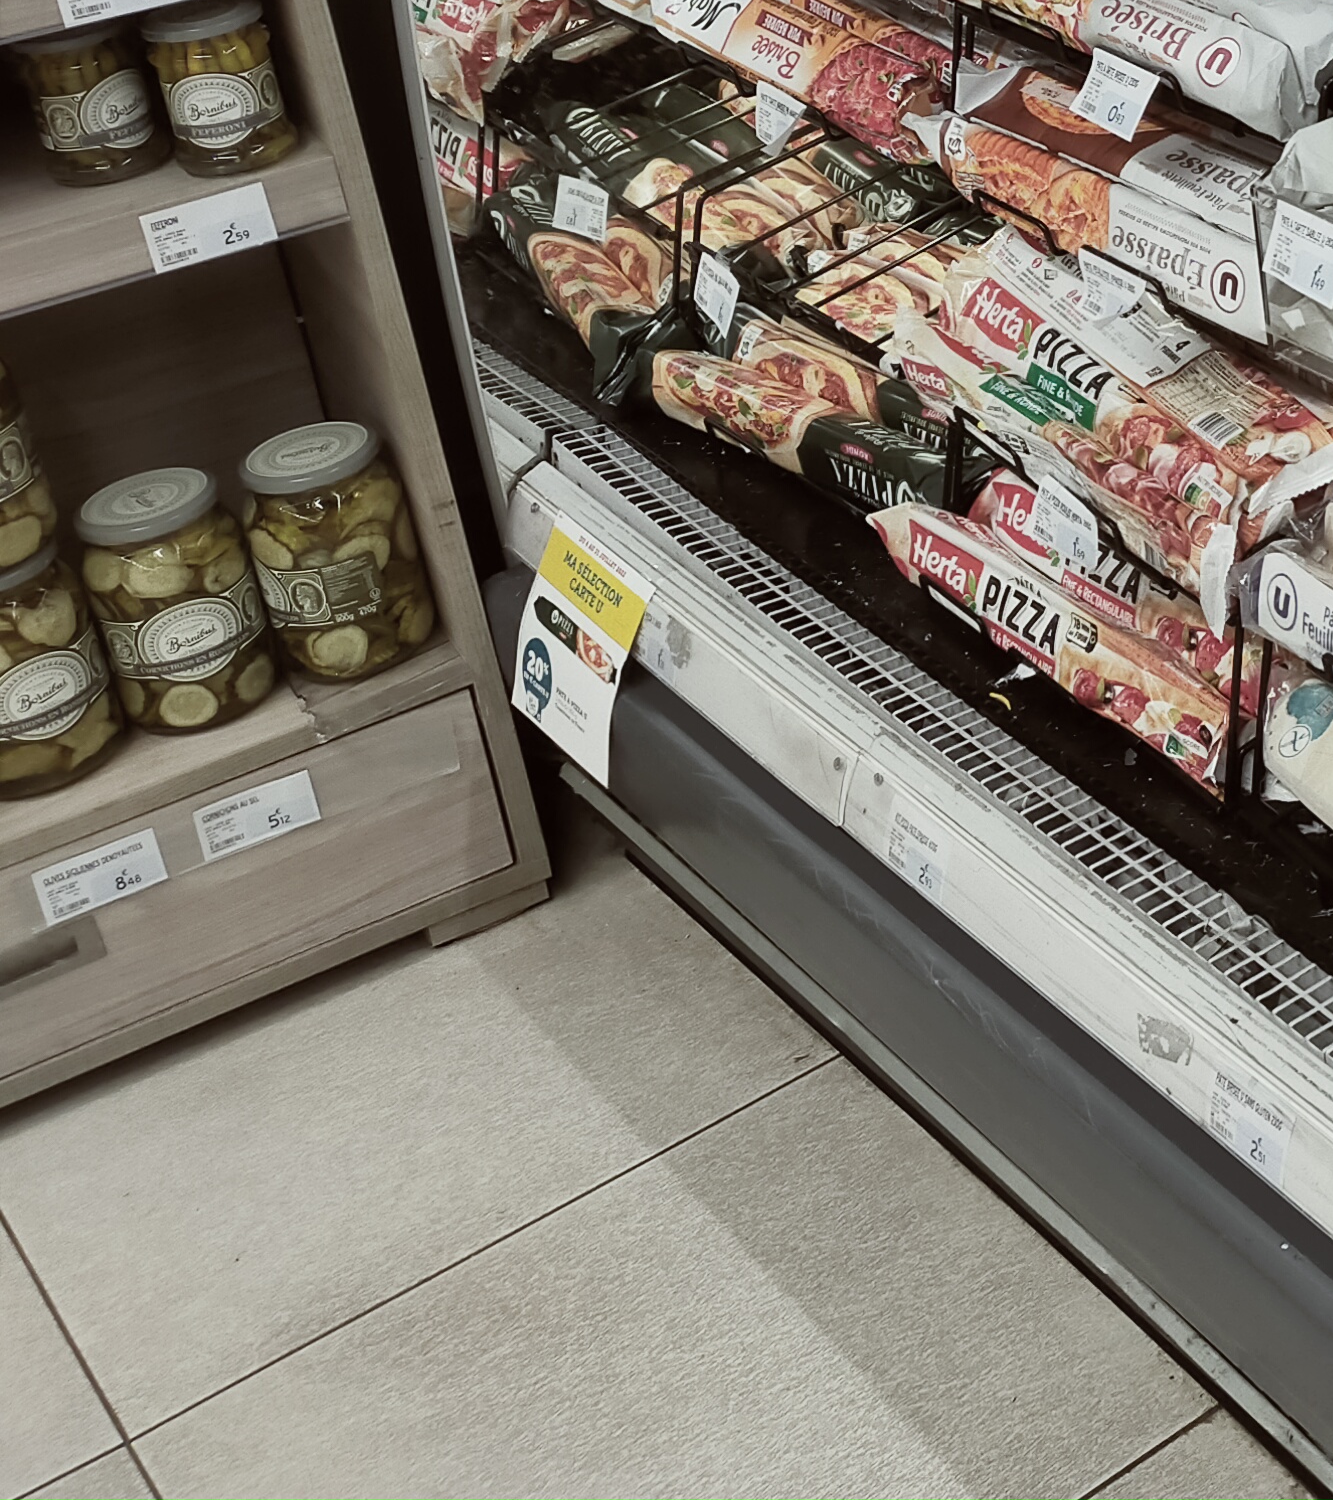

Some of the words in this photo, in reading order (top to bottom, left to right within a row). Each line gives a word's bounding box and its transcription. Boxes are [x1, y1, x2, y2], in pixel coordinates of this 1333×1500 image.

[188, 98, 238, 121] Bornibus
[976, 288, 1024, 340] Herta
[905, 360, 947, 394] Herta
[1032, 329, 1113, 400] PIZZA
[1036, 373, 1056, 391] FINE
[562, 550, 579, 569] MA
[579, 562, 623, 608] SÉLECTION
[913, 534, 967, 592] Herta
[569, 576, 596, 606] CARTE
[596, 601, 604, 614] U
[984, 572, 1063, 656] PIZZA
[165, 622, 218, 655] Bornibus
[16, 679, 69, 712] Bornibus
